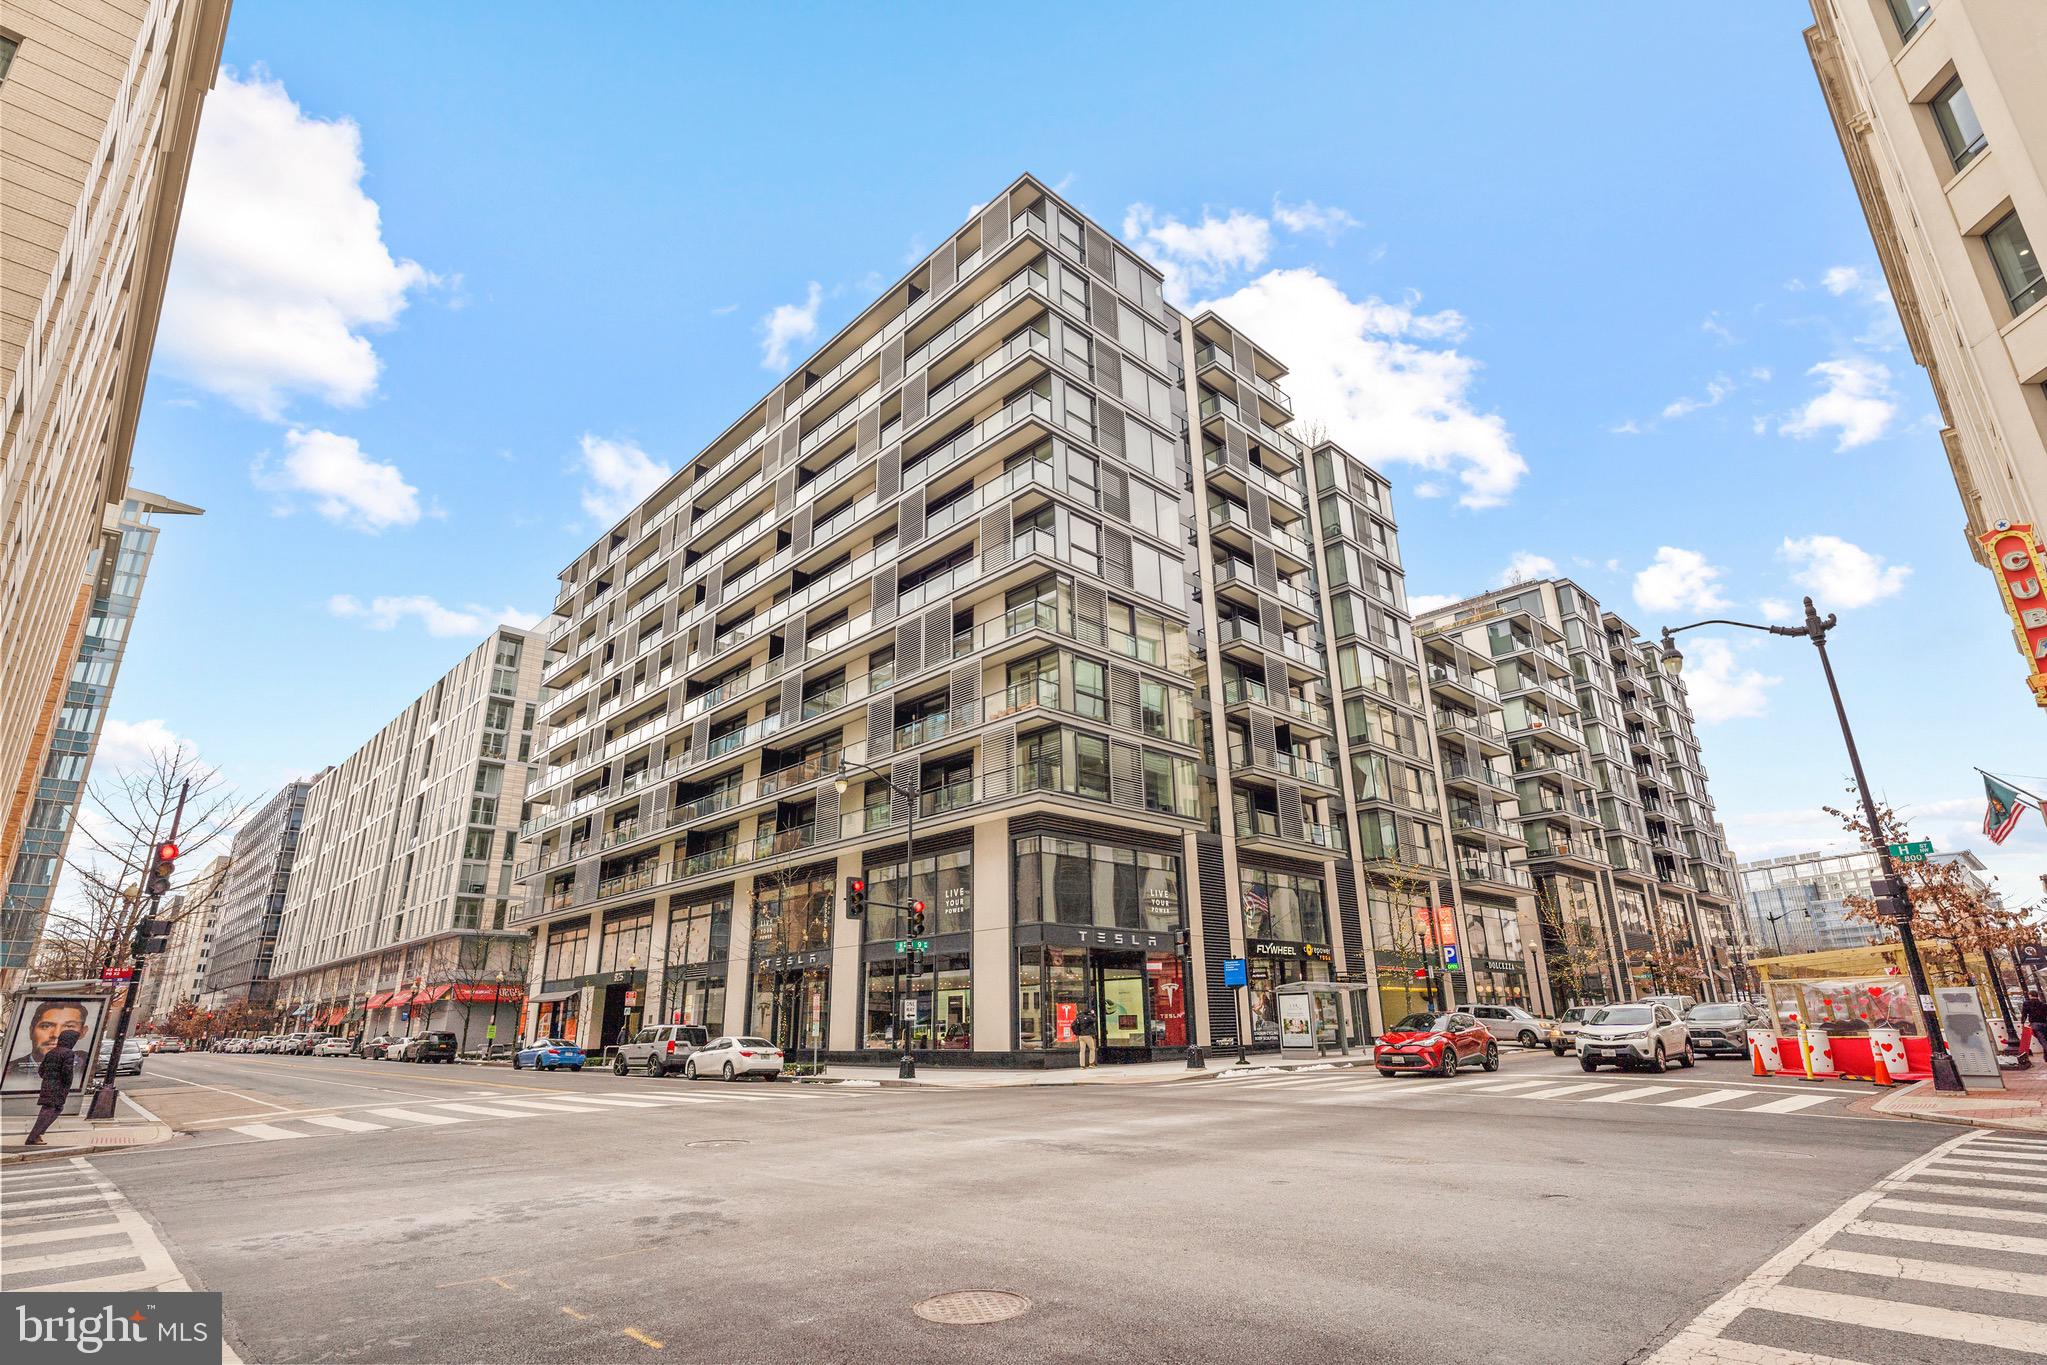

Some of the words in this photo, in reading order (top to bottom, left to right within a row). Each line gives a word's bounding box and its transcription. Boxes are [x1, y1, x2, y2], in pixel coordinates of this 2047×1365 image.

[1898, 845, 1910, 855] H
[1904, 854, 1922, 862] 800
[945, 887, 964, 898] LIVE
[1150, 889, 1169, 898] LIVE
[945, 898, 964, 906] YOUR
[1151, 899, 1169, 907] YOUR
[760, 919, 773, 927] LIVE
[1078, 931, 1157, 946] TESLA
[1256, 942, 1297, 956] FLYWHEEL
[1443, 947, 1455, 962] P
[765, 953, 817, 968] TESLA
[1488, 961, 1515, 970] DOLCEZZA
